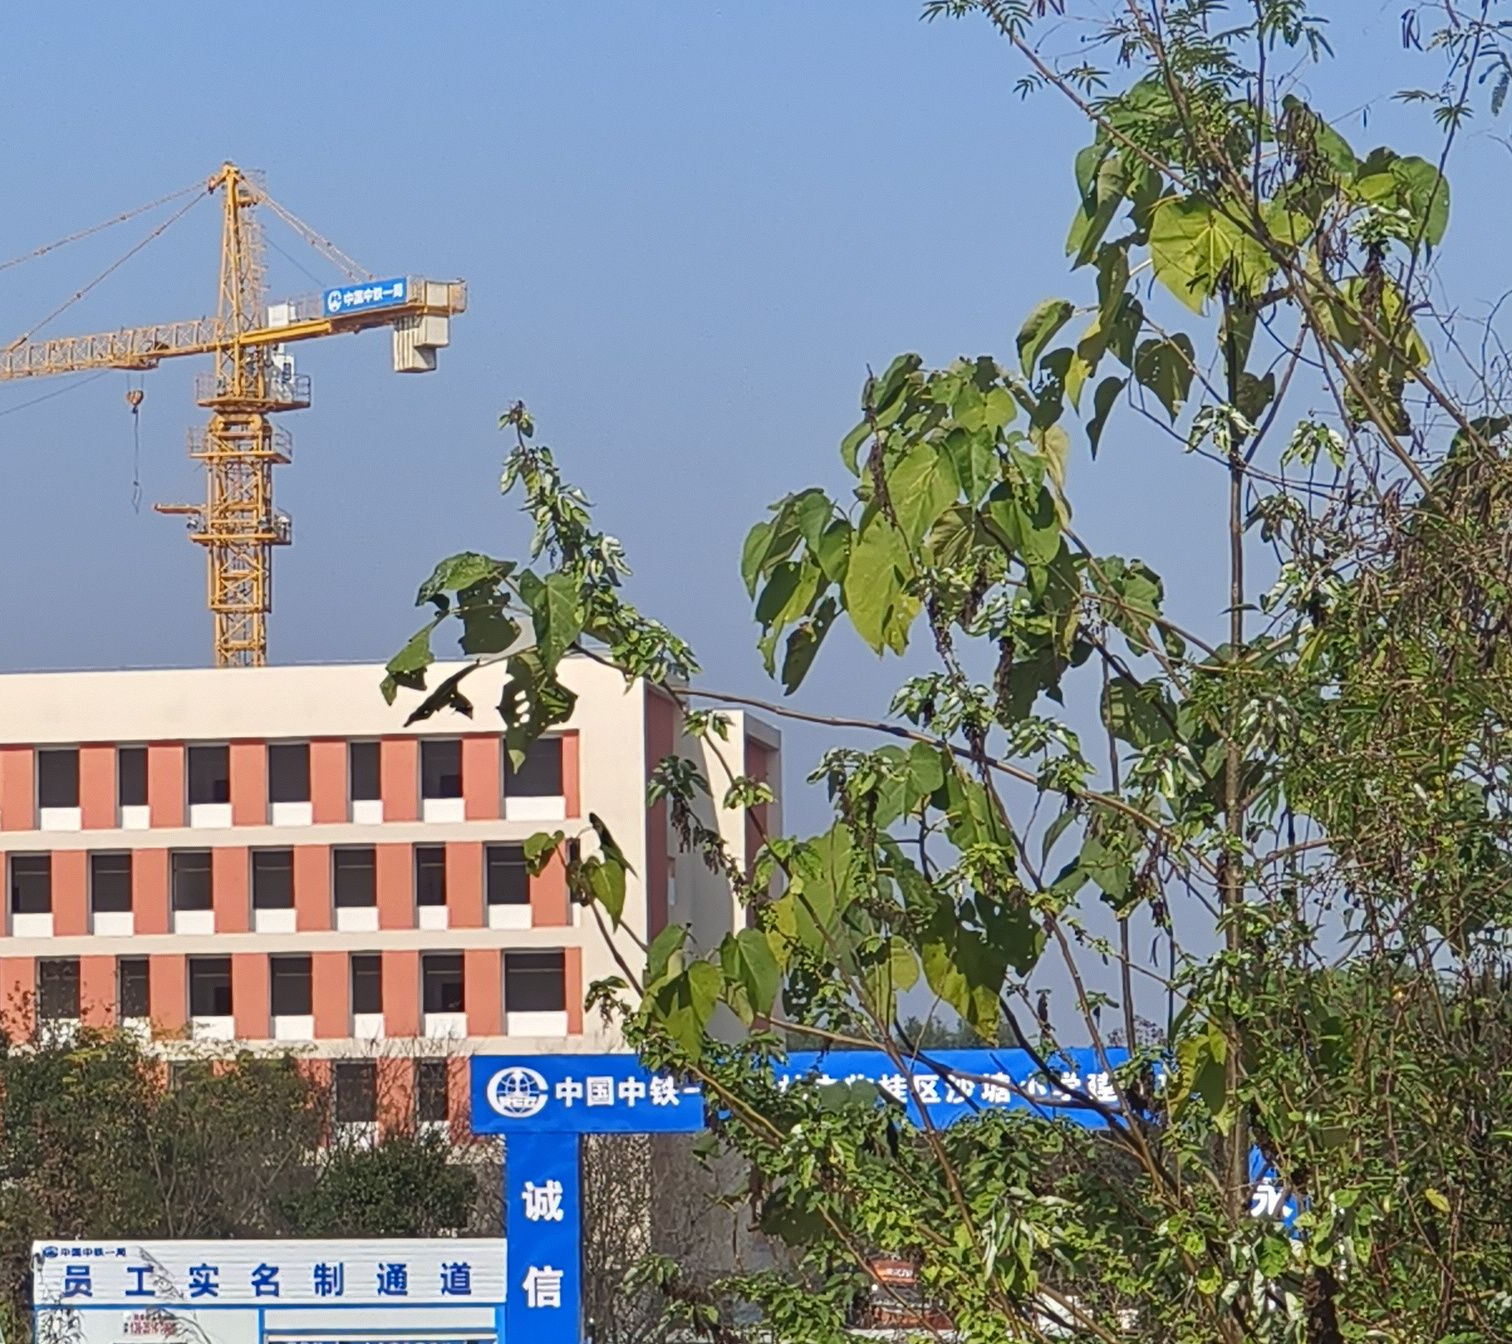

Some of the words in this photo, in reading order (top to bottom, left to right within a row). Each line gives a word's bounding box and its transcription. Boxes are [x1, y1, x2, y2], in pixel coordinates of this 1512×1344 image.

[343, 283, 404, 307] 中国中铁一局
[555, 1076, 702, 1108] 中国中铁一
[63, 1262, 473, 1298] 员工实名制通道
